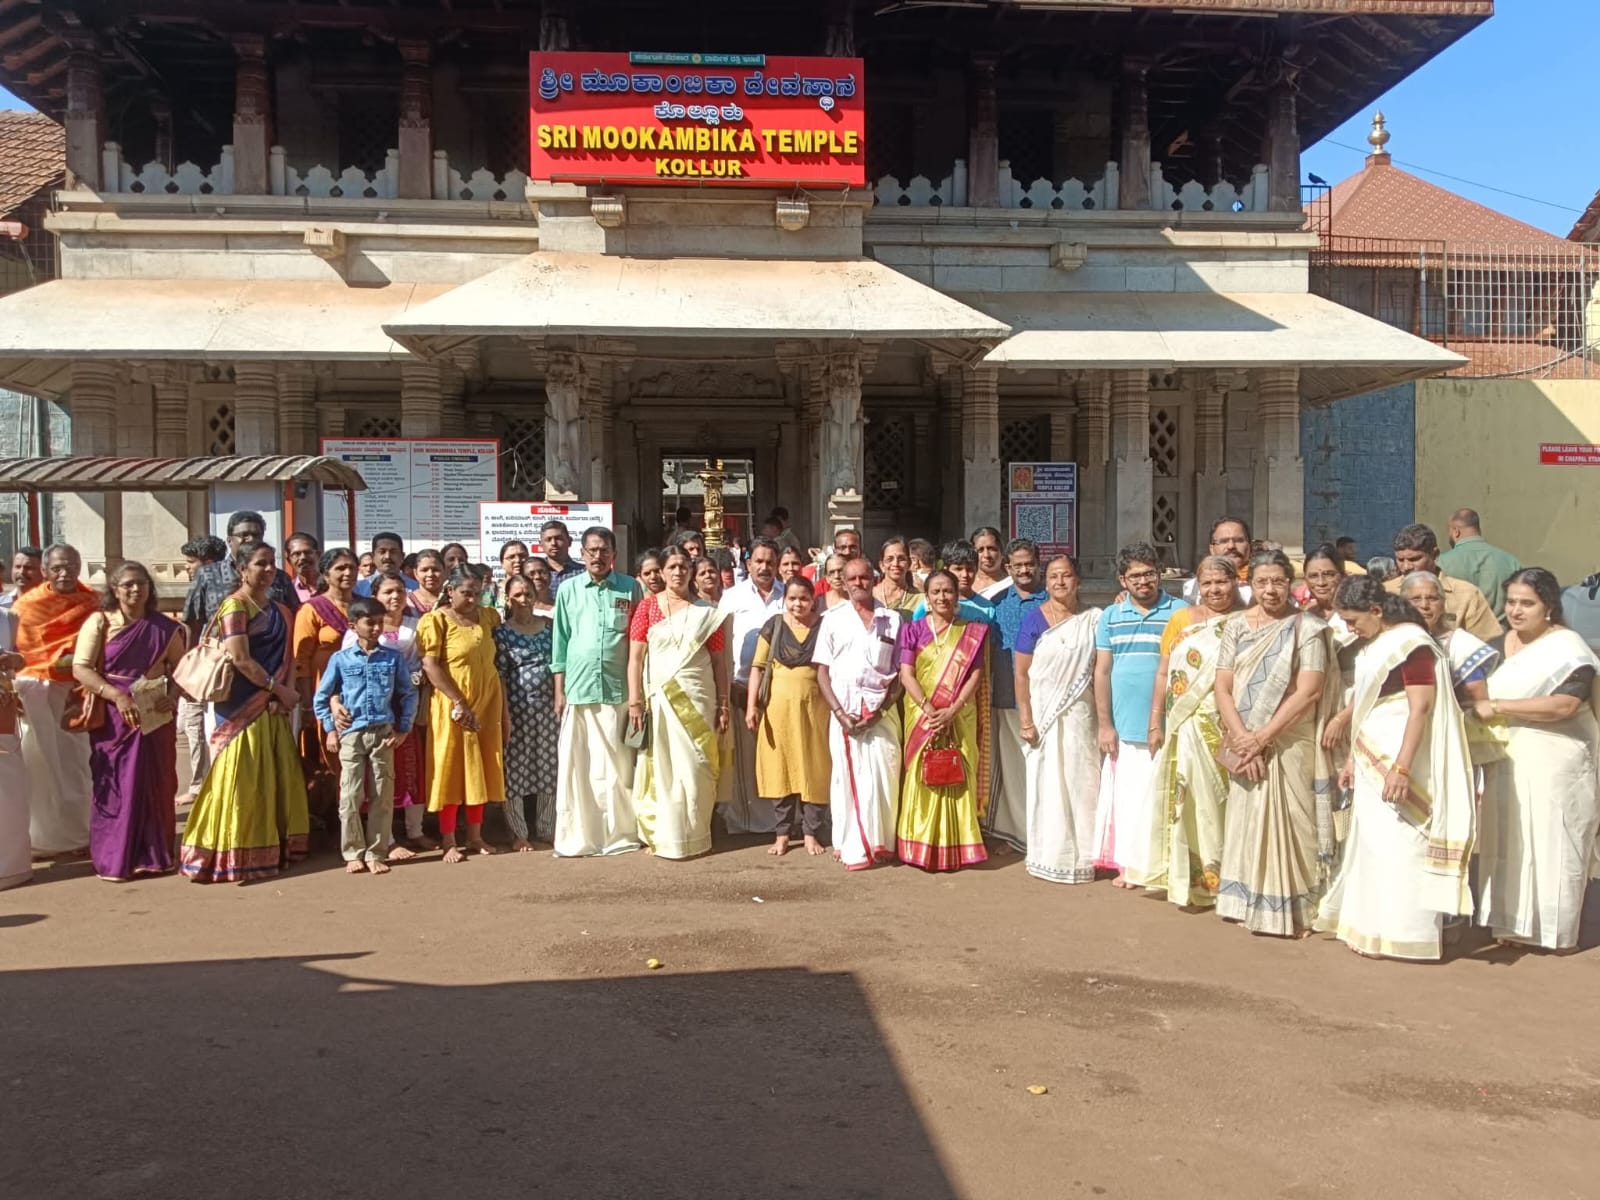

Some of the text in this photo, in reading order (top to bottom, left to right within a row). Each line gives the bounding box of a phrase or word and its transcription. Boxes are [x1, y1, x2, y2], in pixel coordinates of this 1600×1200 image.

[539, 67, 856, 111] ಶ್ರೀ ಮೂಕಾಂಬಿಕಾ ದೇವಸ್ಥಾನ
[654, 101, 744, 125] ಕೊಲ್ಲೂರು
[537, 124, 858, 154] SRI MOOKAMBIKA TEMPLE
[655, 158, 742, 176] KOLLUR
